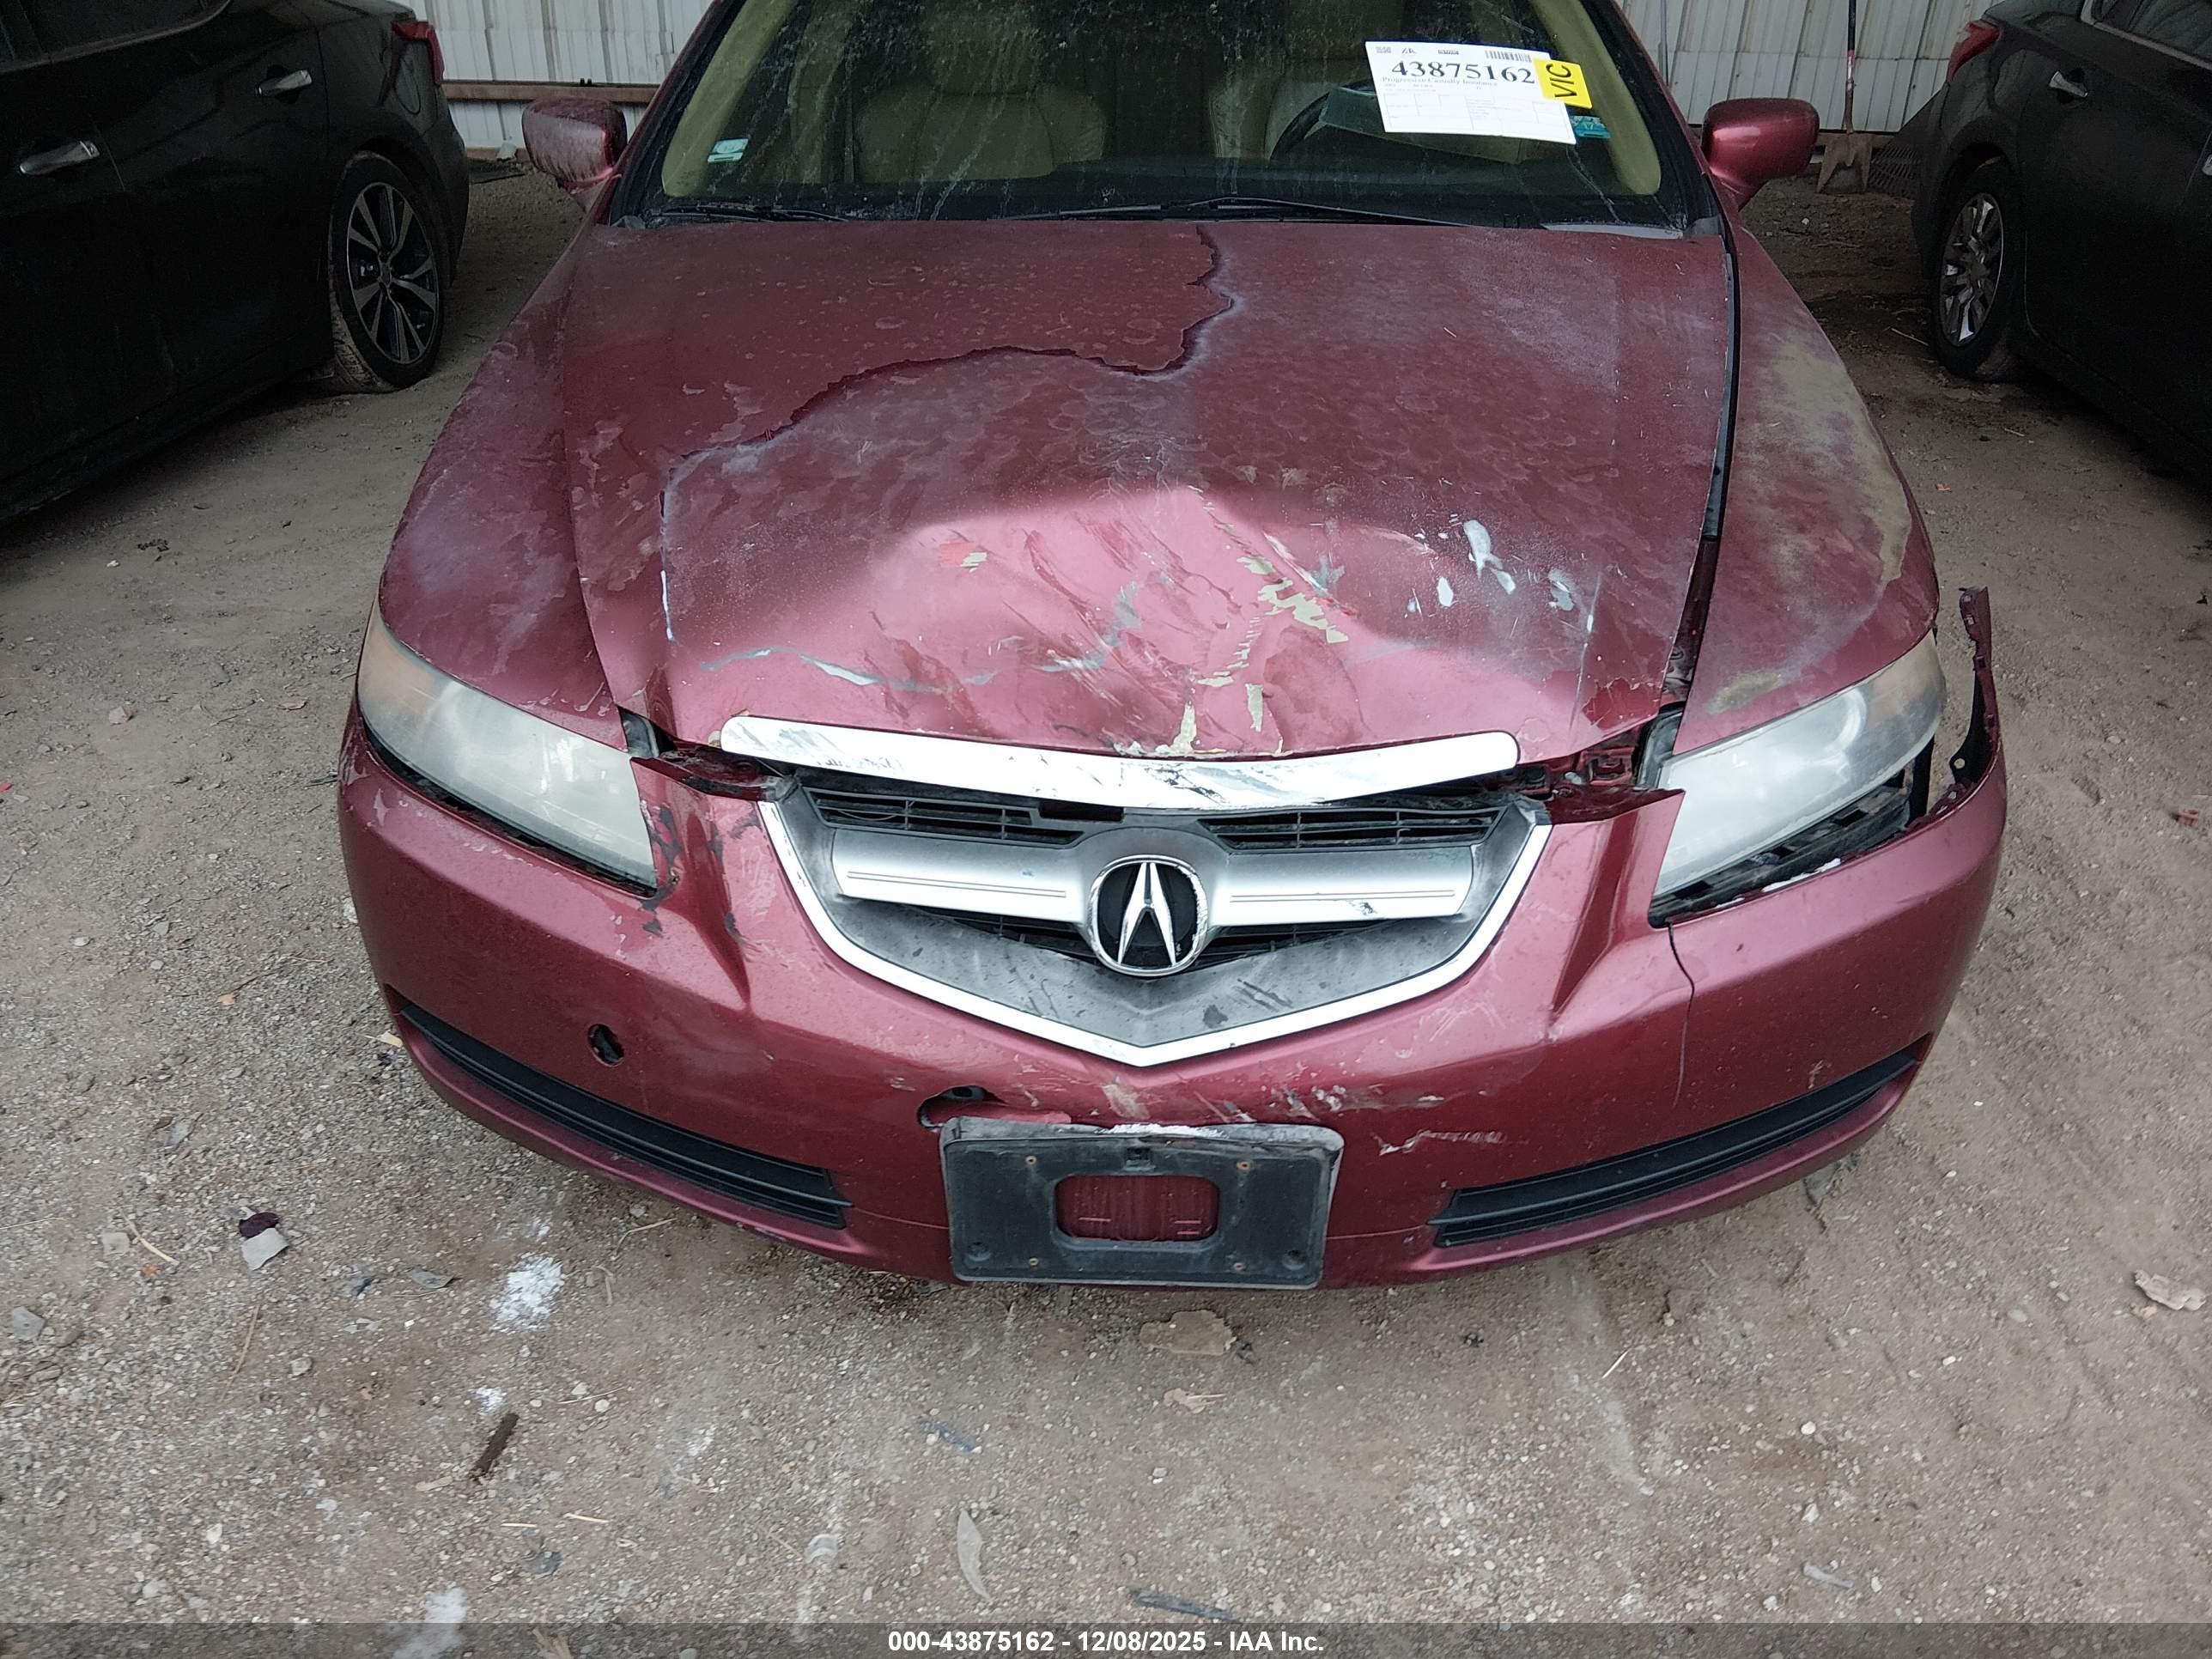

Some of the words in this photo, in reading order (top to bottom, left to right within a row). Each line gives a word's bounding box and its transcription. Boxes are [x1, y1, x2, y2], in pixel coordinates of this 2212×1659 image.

[1382, 76, 1425, 84] Progressive
[1391, 60, 1535, 84] 43875162
[1546, 64, 1577, 99] VIC
